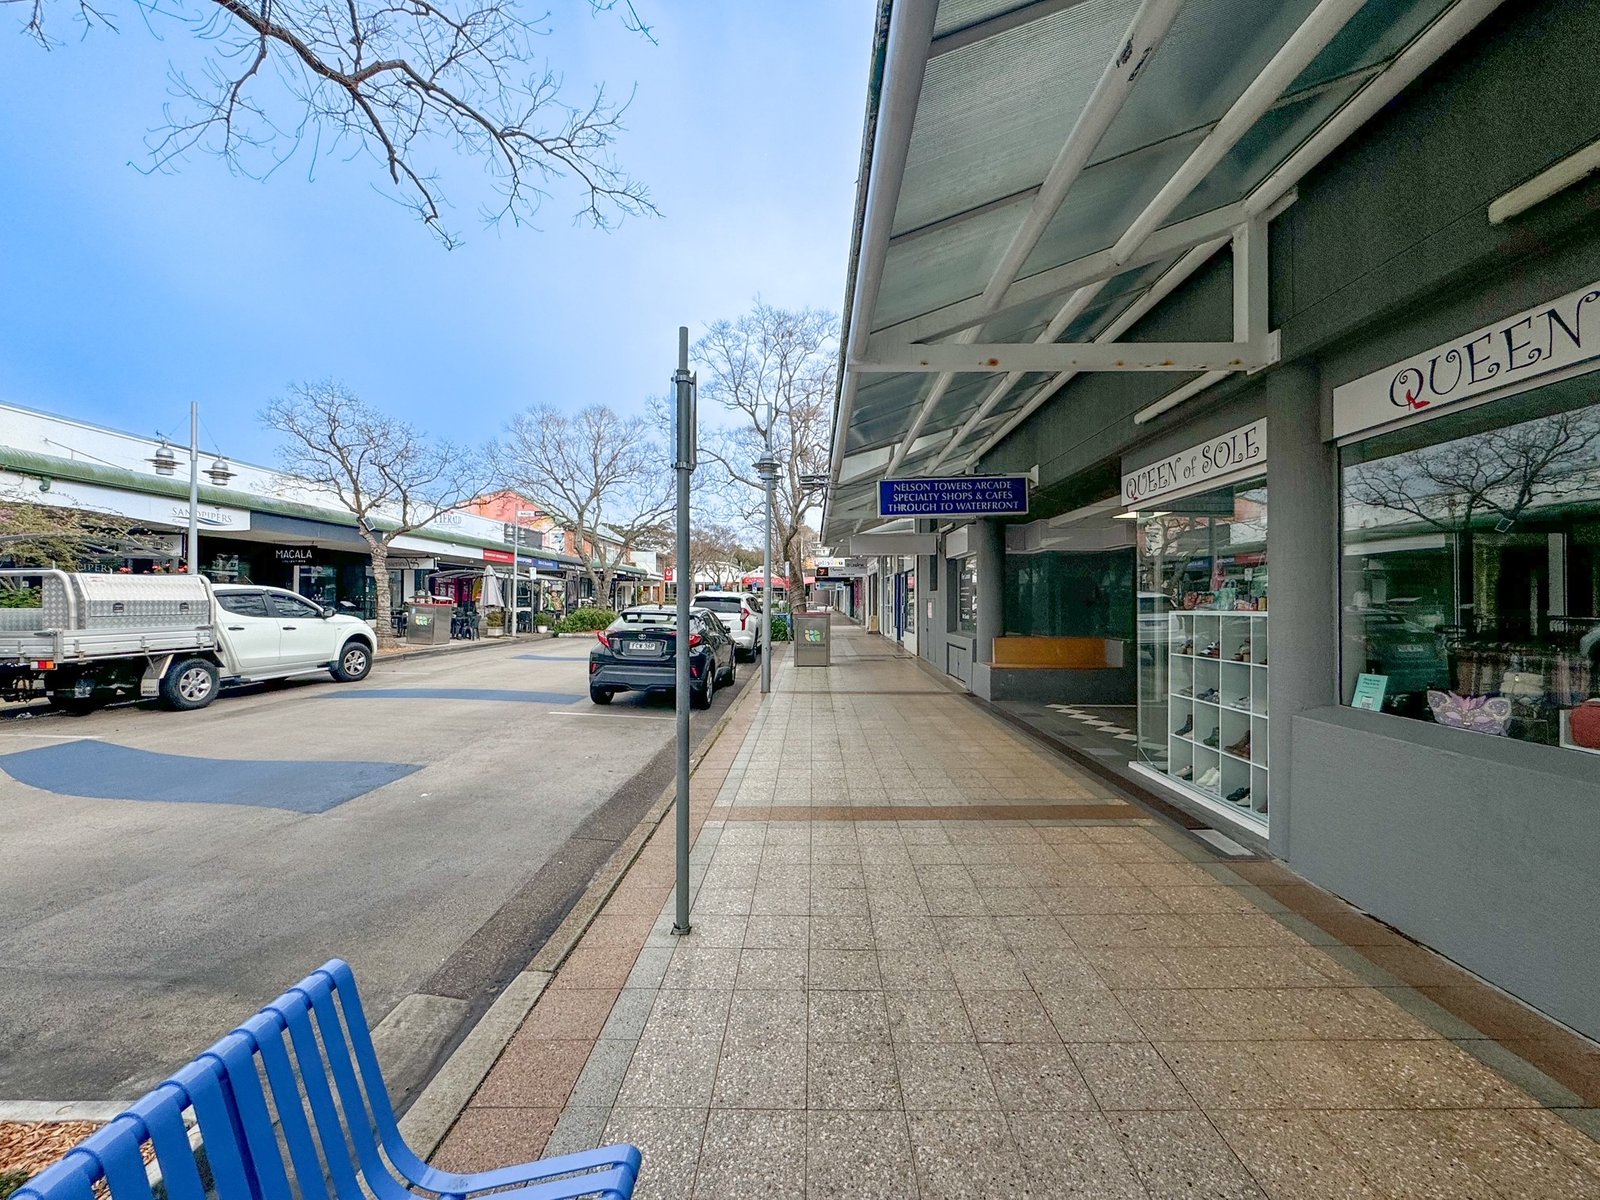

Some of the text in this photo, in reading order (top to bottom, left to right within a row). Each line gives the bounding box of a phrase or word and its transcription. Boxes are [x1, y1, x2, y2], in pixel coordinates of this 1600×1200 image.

[1389, 290, 1600, 409] QUEEN
[1126, 426, 1260, 500] QUEEN of SOLE
[893, 480, 1012, 491] NELSON TOWERS ARCADE
[893, 490, 1013, 502] SPECIALTY SHOPS & CAFES
[888, 501, 1019, 512] THROUGH TO WATERFRONT
[275, 549, 313, 559] MACALA
